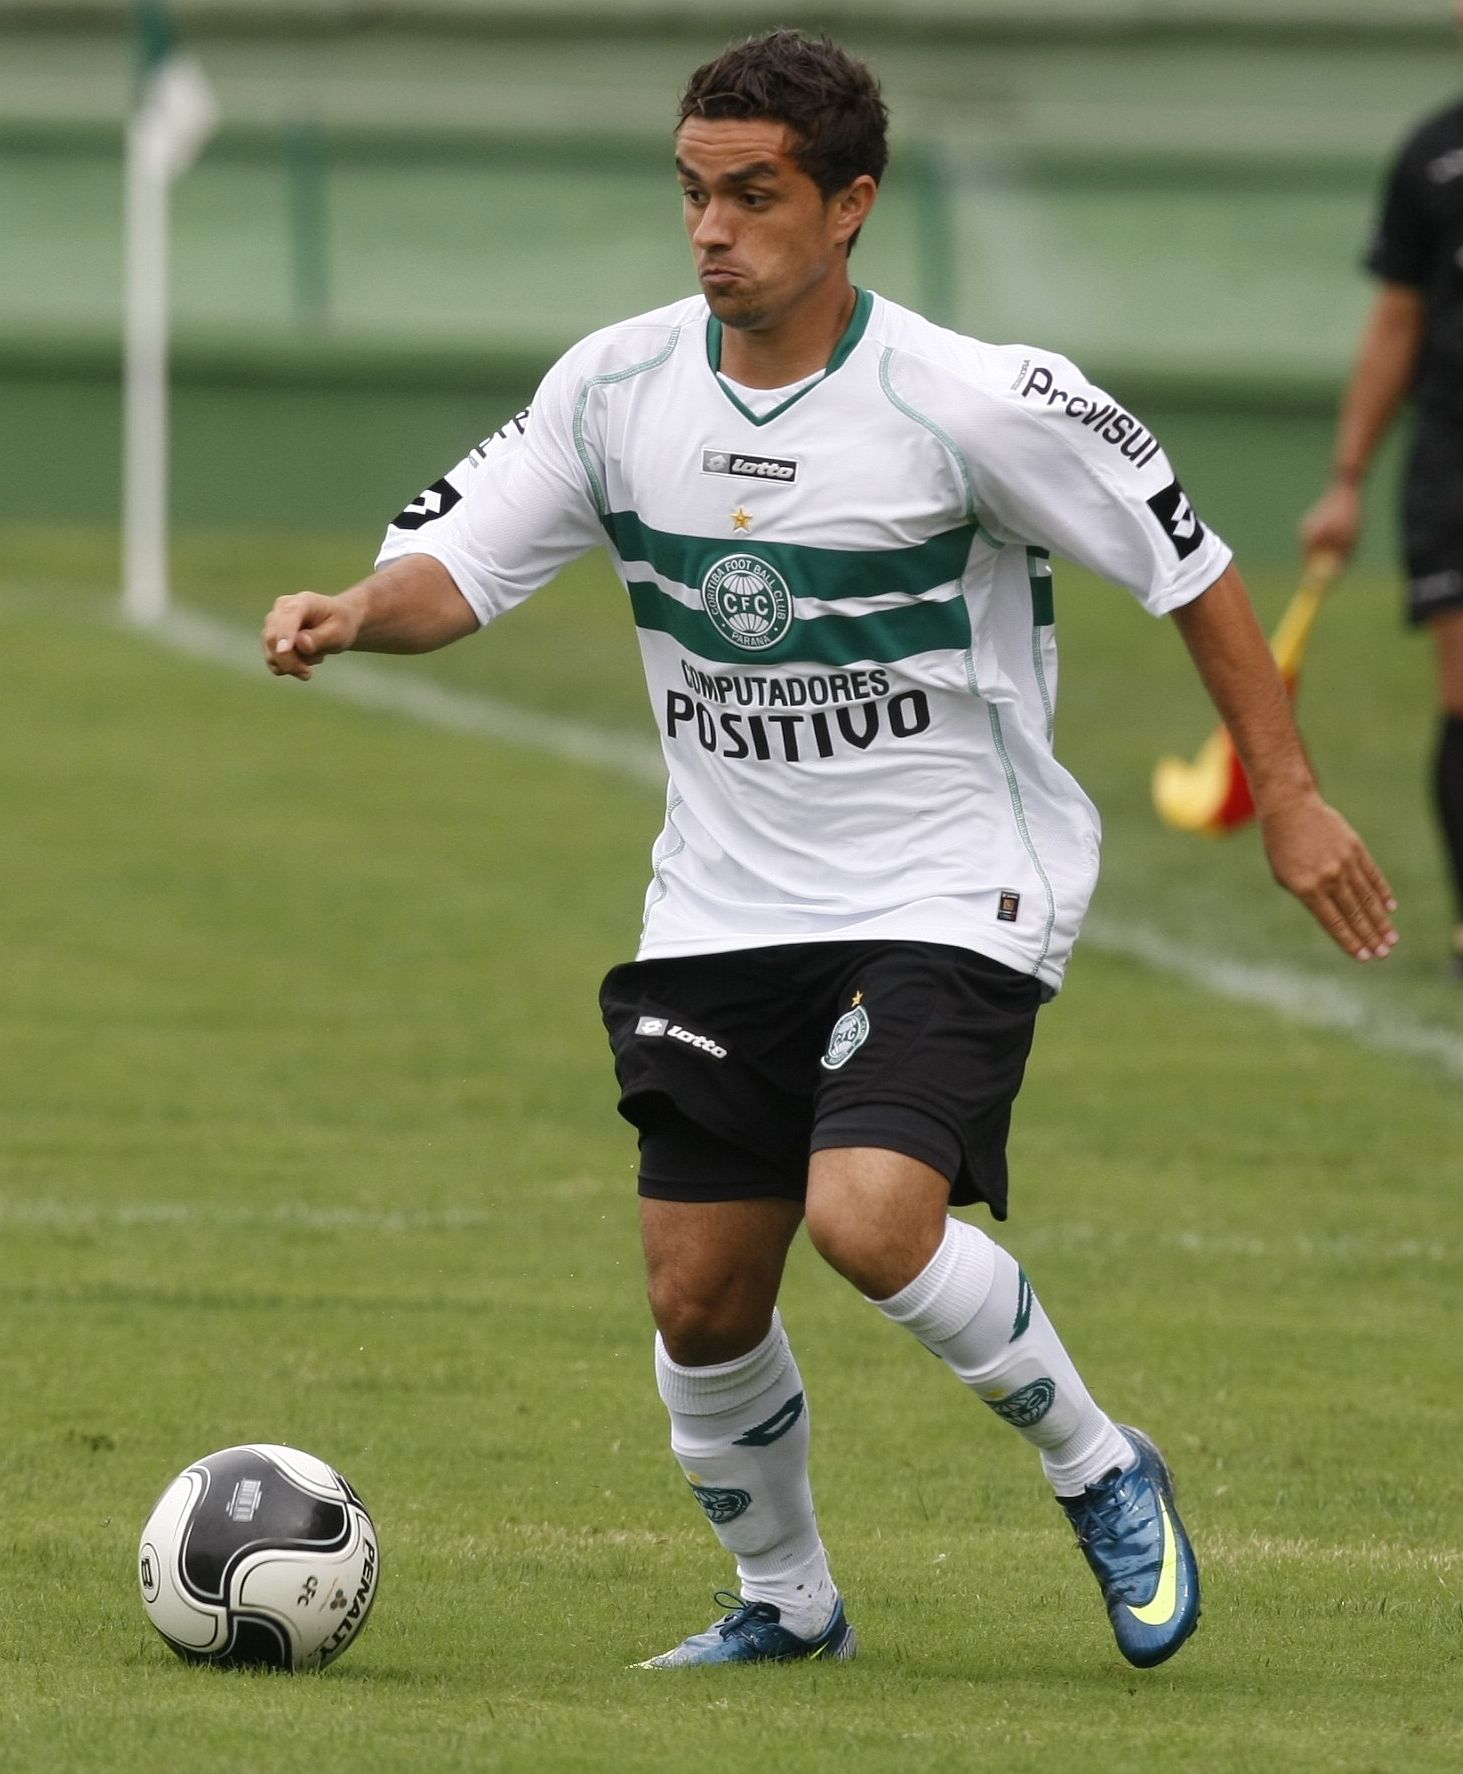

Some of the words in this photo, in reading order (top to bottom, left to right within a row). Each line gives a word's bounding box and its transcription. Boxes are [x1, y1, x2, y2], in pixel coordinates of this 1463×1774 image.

[707, 568, 725, 615] CORITIBA
[724, 559, 752, 572] FOOT
[752, 564, 776, 589] BALL
[774, 590, 786, 620] CLUB
[723, 592, 769, 616] CFC
[681, 658, 890, 707] COMPUTADORES
[666, 688, 931, 762] POSITIVO
[320, 1538, 375, 1660] PENALTY
